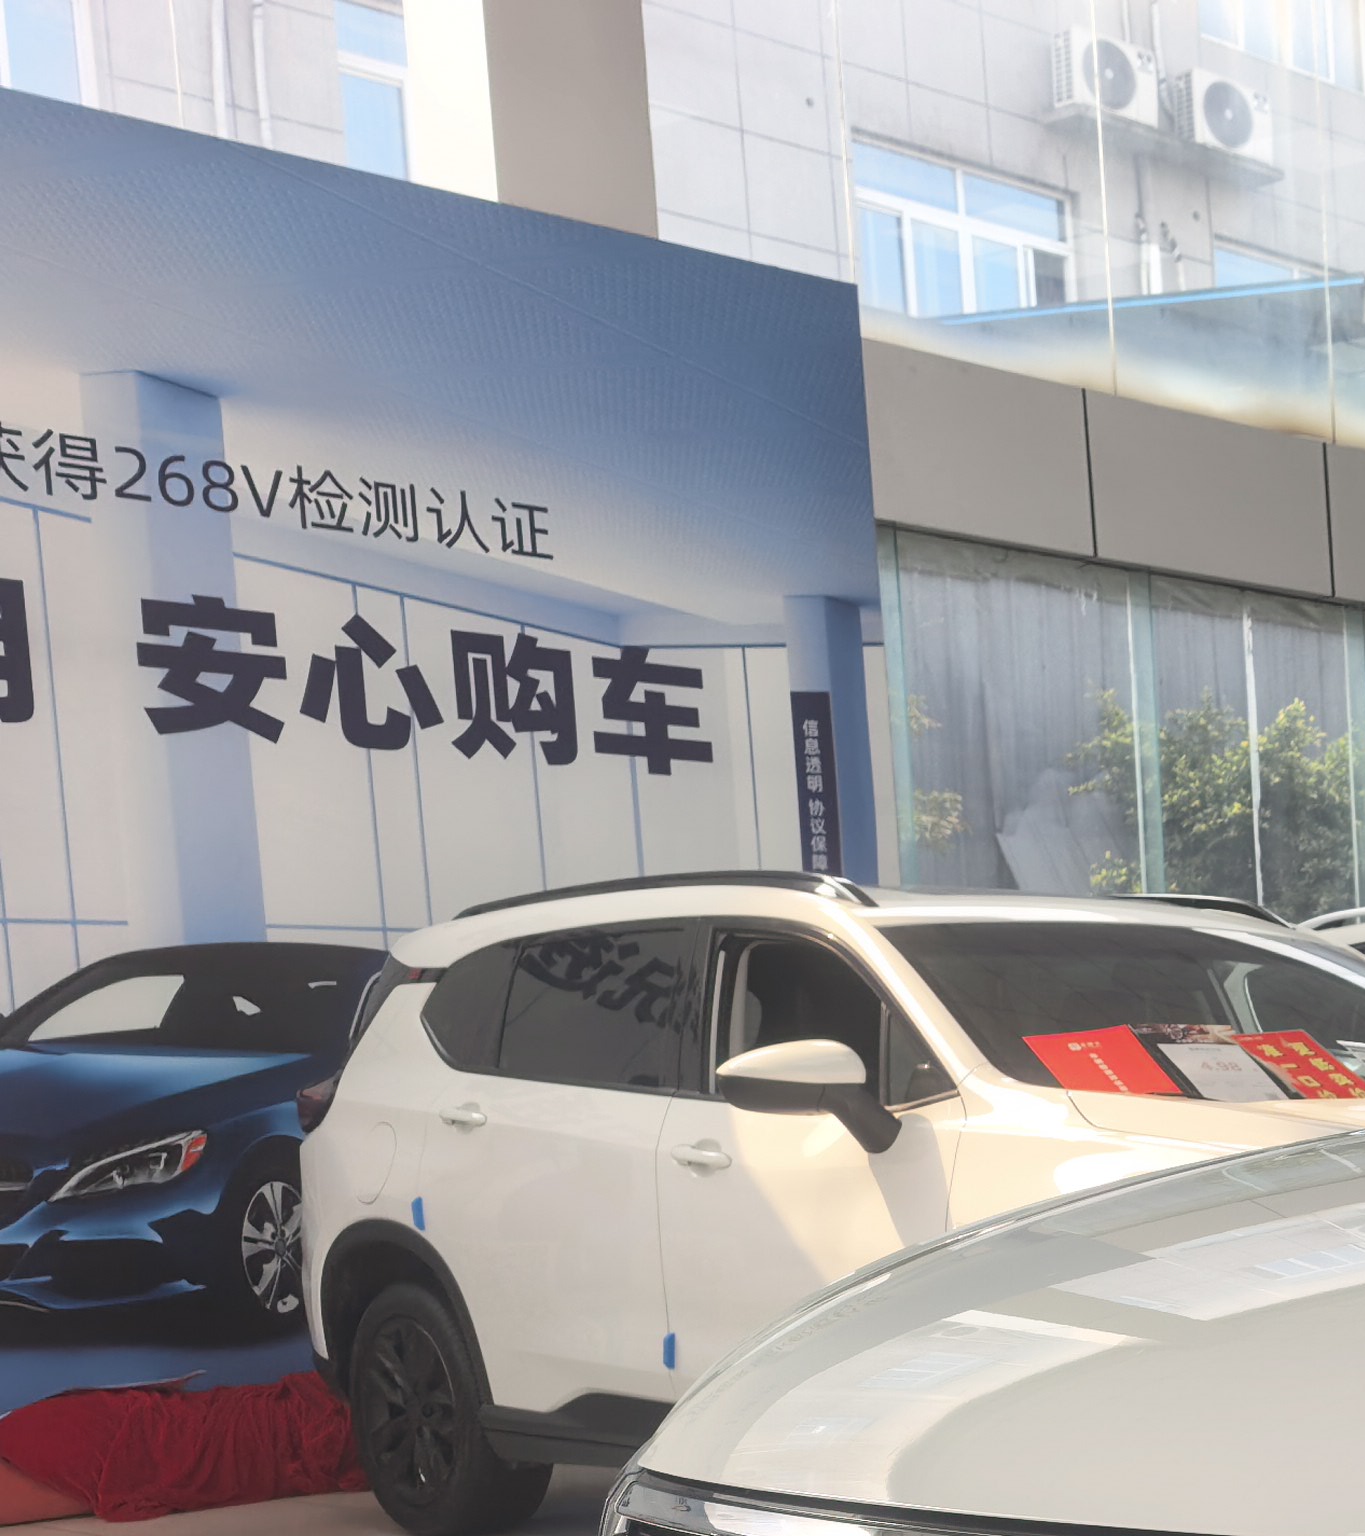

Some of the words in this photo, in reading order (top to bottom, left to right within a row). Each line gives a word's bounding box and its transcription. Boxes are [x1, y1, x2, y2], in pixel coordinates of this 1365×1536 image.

[136, 594, 714, 776] 安心购车
[803, 719, 823, 793] 信息透明
[808, 799, 829, 871] 协议保障
